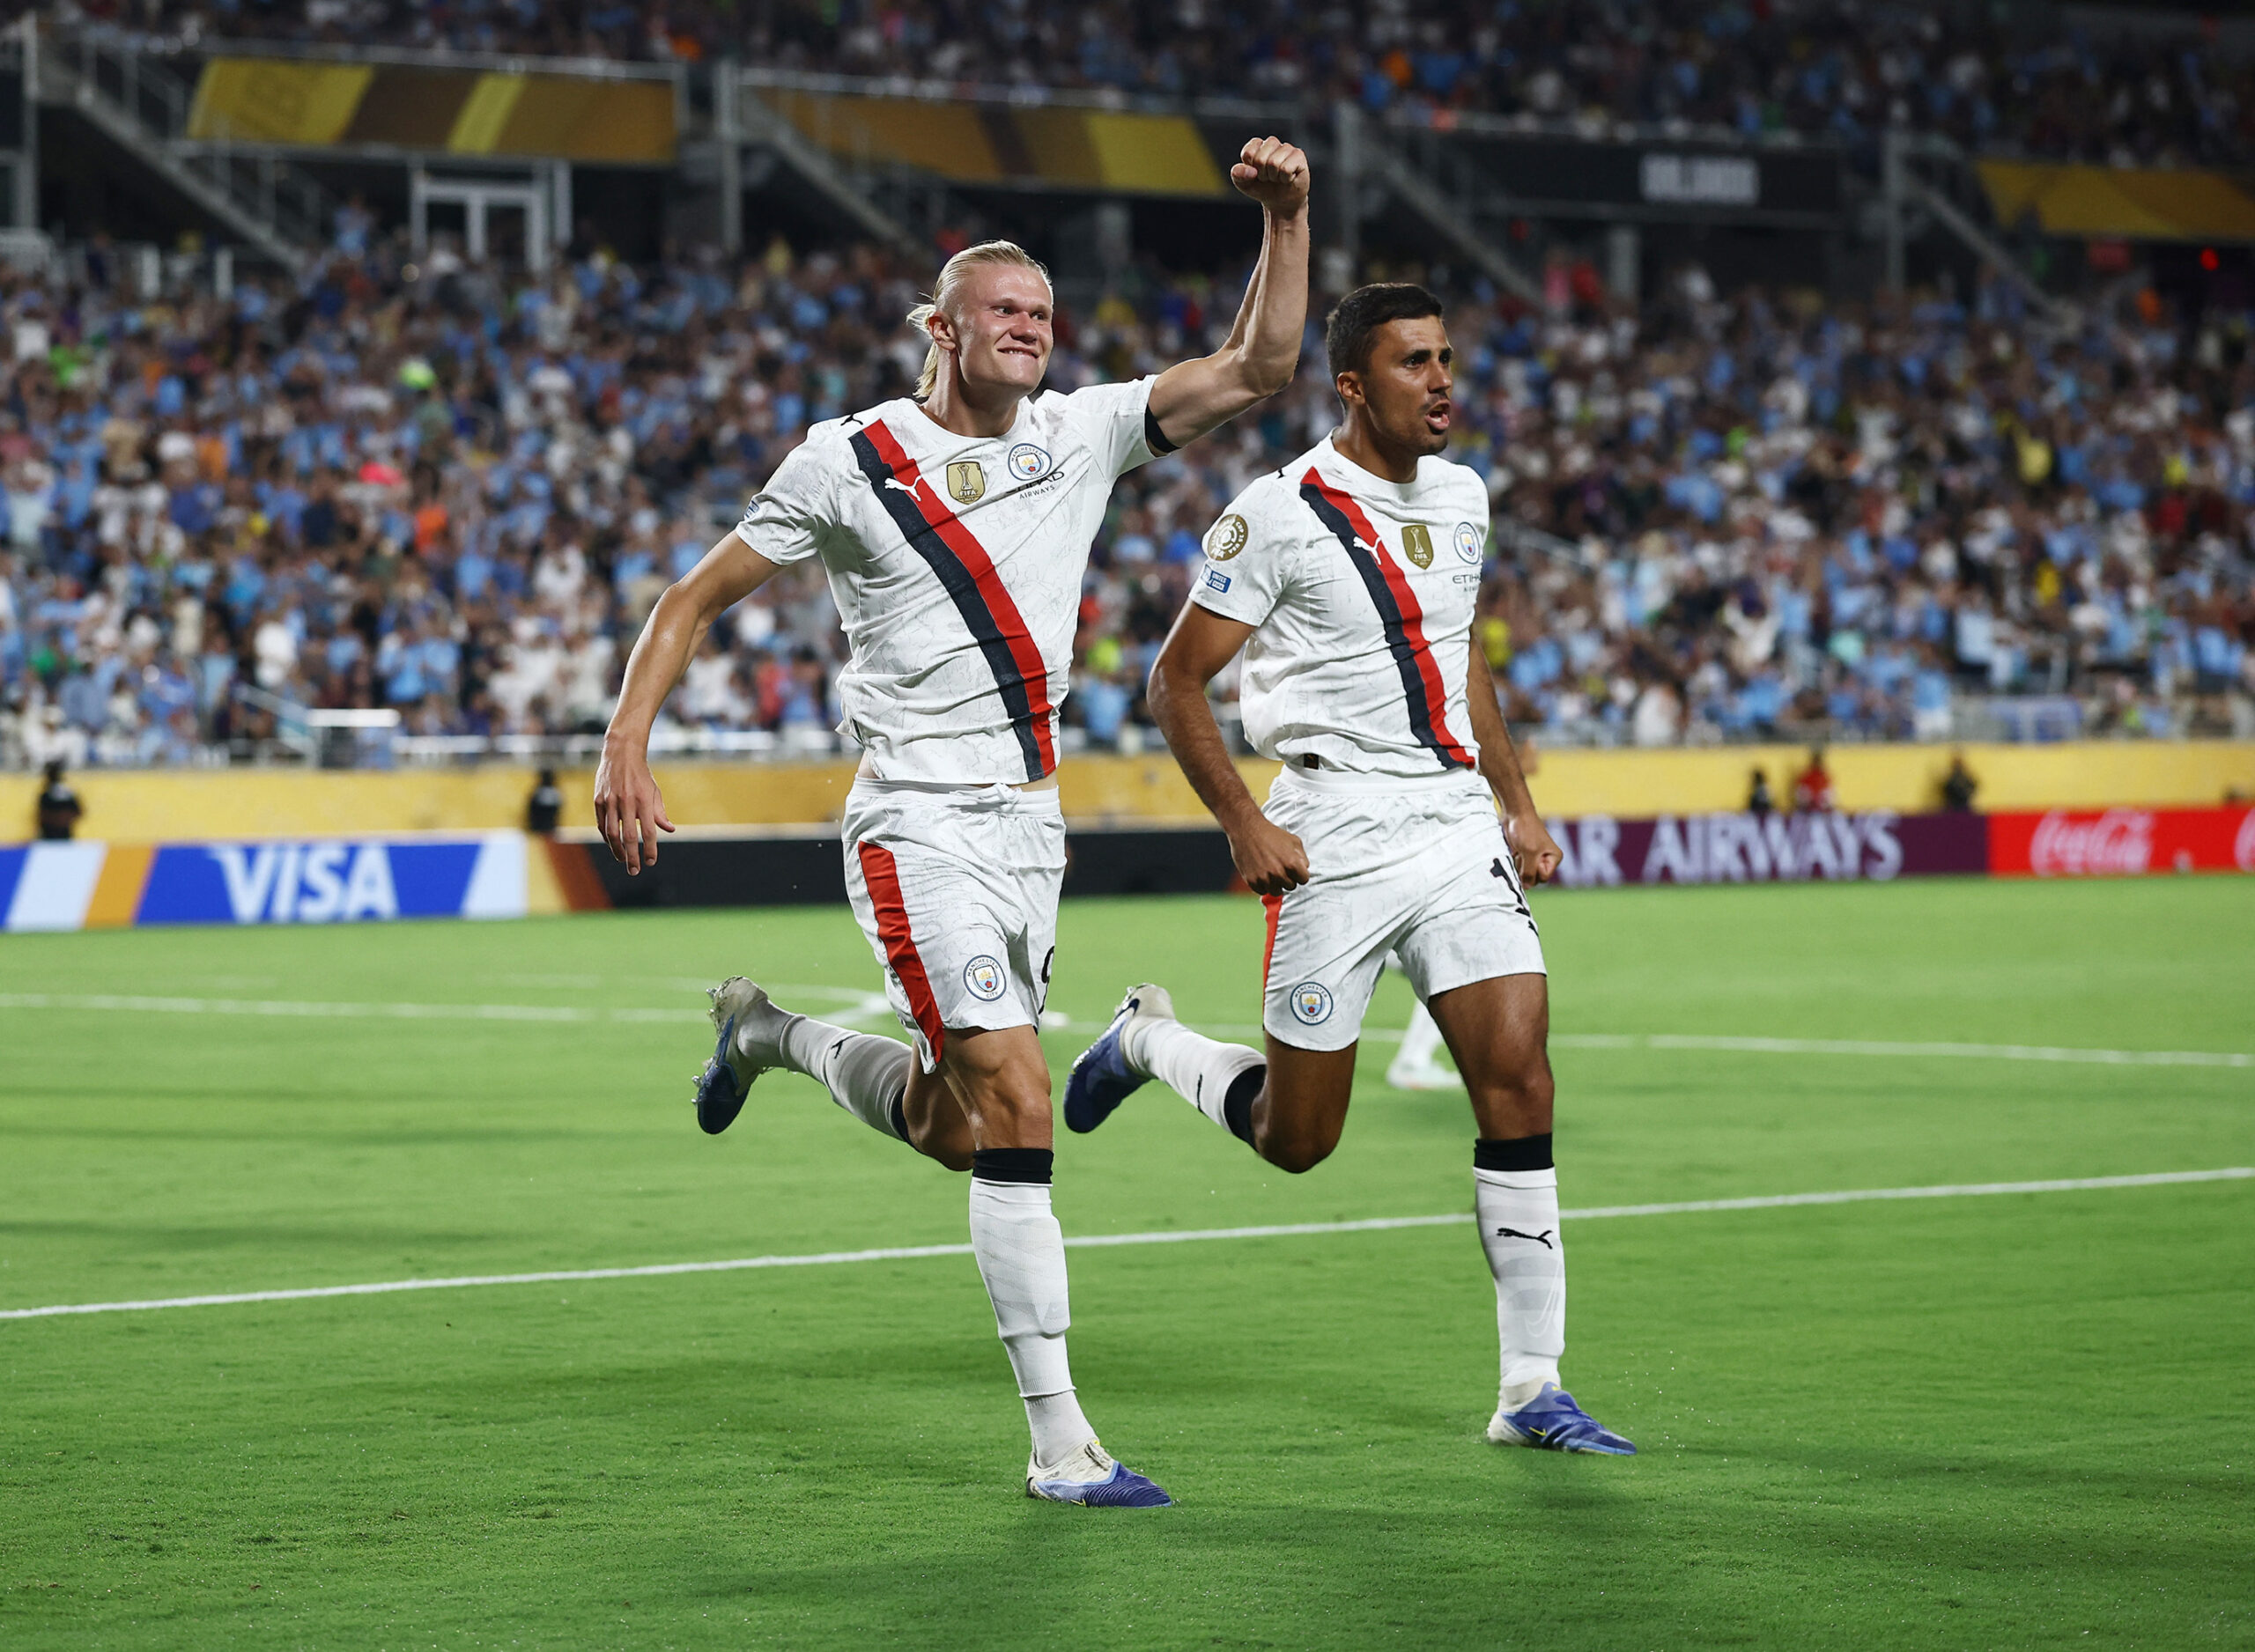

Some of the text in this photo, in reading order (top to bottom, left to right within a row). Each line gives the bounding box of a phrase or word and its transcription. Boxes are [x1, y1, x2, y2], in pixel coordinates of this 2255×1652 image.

[1011, 446, 1044, 461] MANCHESTER
[1019, 484, 1055, 499] AIRWAYS
[1642, 810, 1903, 884] AIRWAYS
[208, 843, 399, 923] VISA
[967, 958, 999, 977] MANCHESTER
[1295, 985, 1327, 999] MANCHESTER
